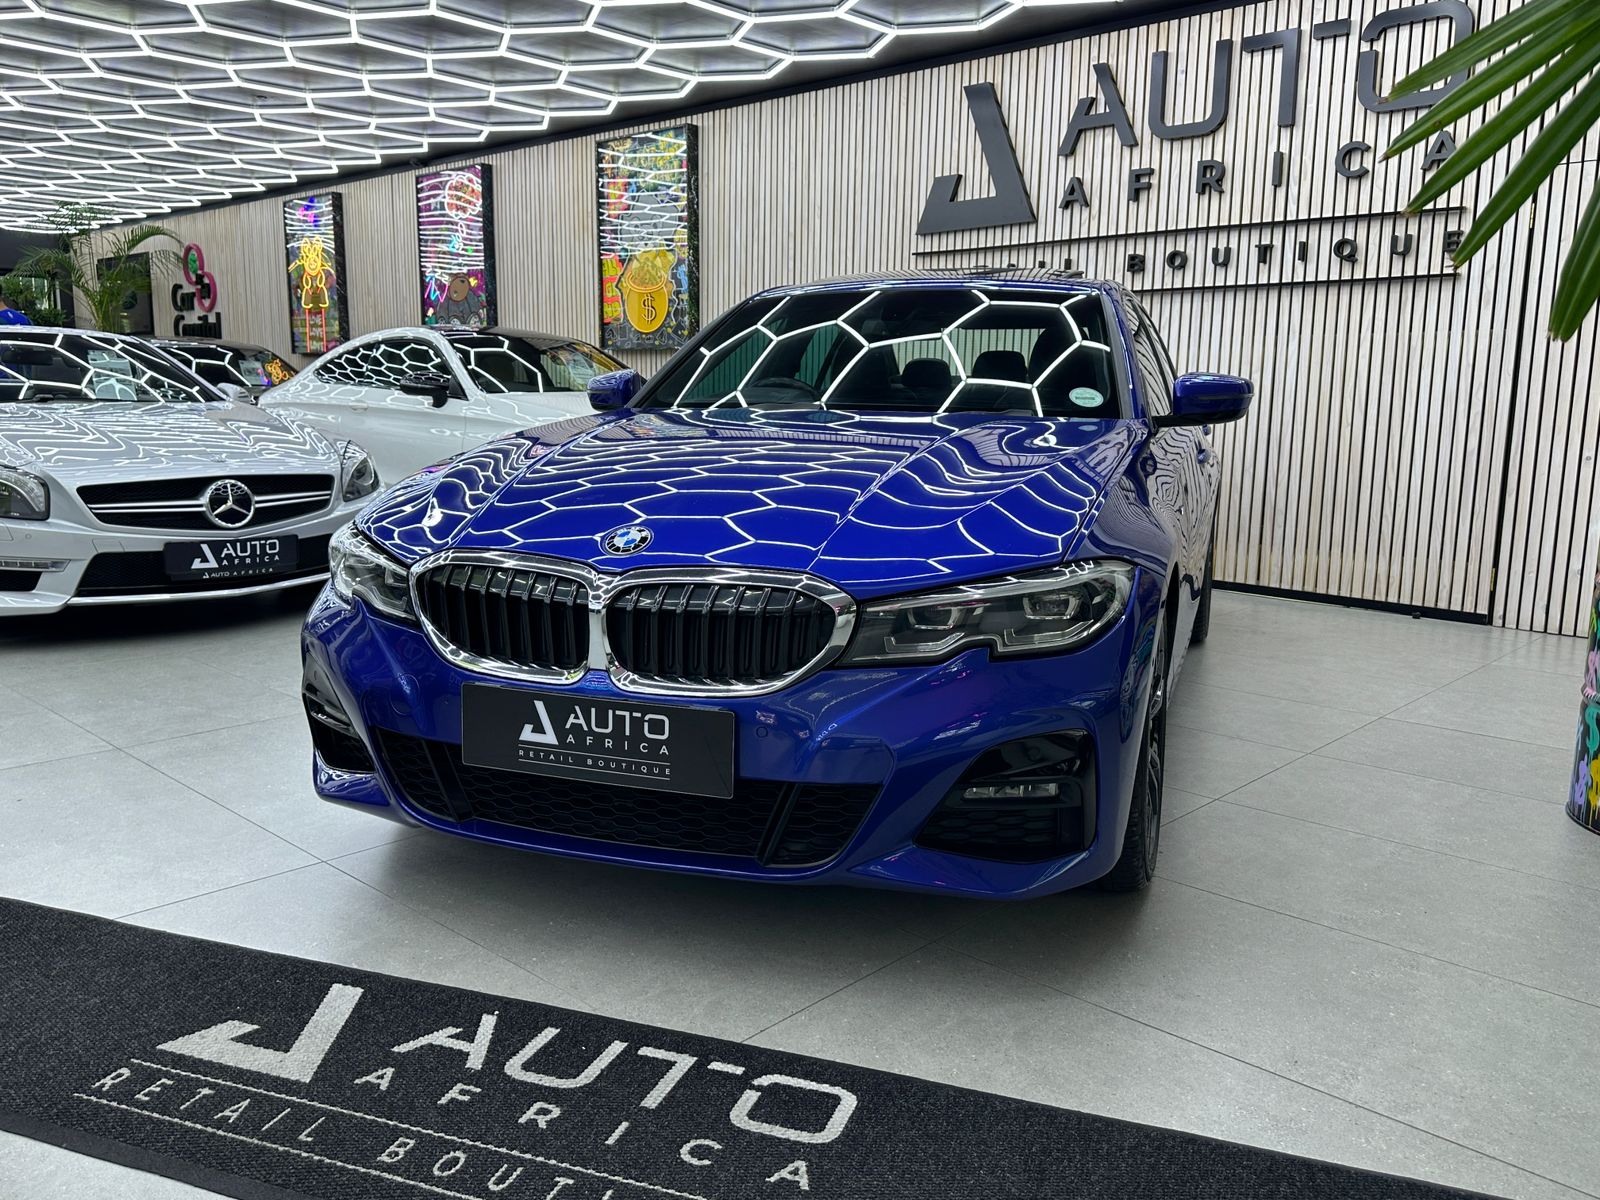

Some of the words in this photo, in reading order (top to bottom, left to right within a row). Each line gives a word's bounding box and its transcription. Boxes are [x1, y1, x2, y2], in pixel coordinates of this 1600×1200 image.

[1058, 0, 1475, 156] AUTO
[1058, 131, 1457, 209] AFRICA
[1127, 230, 1464, 273] BOUTIQUE
[171, 283, 197, 312] Car
[221, 539, 279, 557] AUTO
[222, 555, 279, 566] AFRICA
[233, 568, 273, 576] AFRICA
[565, 705, 670, 740] AUTO
[519, 750, 574, 763] RETAIL
[587, 758, 670, 775] BOUTIQUE
[566, 735, 669, 756] AFRICA
[391, 1013, 858, 1143] AUTO
[91, 1067, 326, 1142] RETAIL
[354, 1067, 810, 1190] AFRICA
